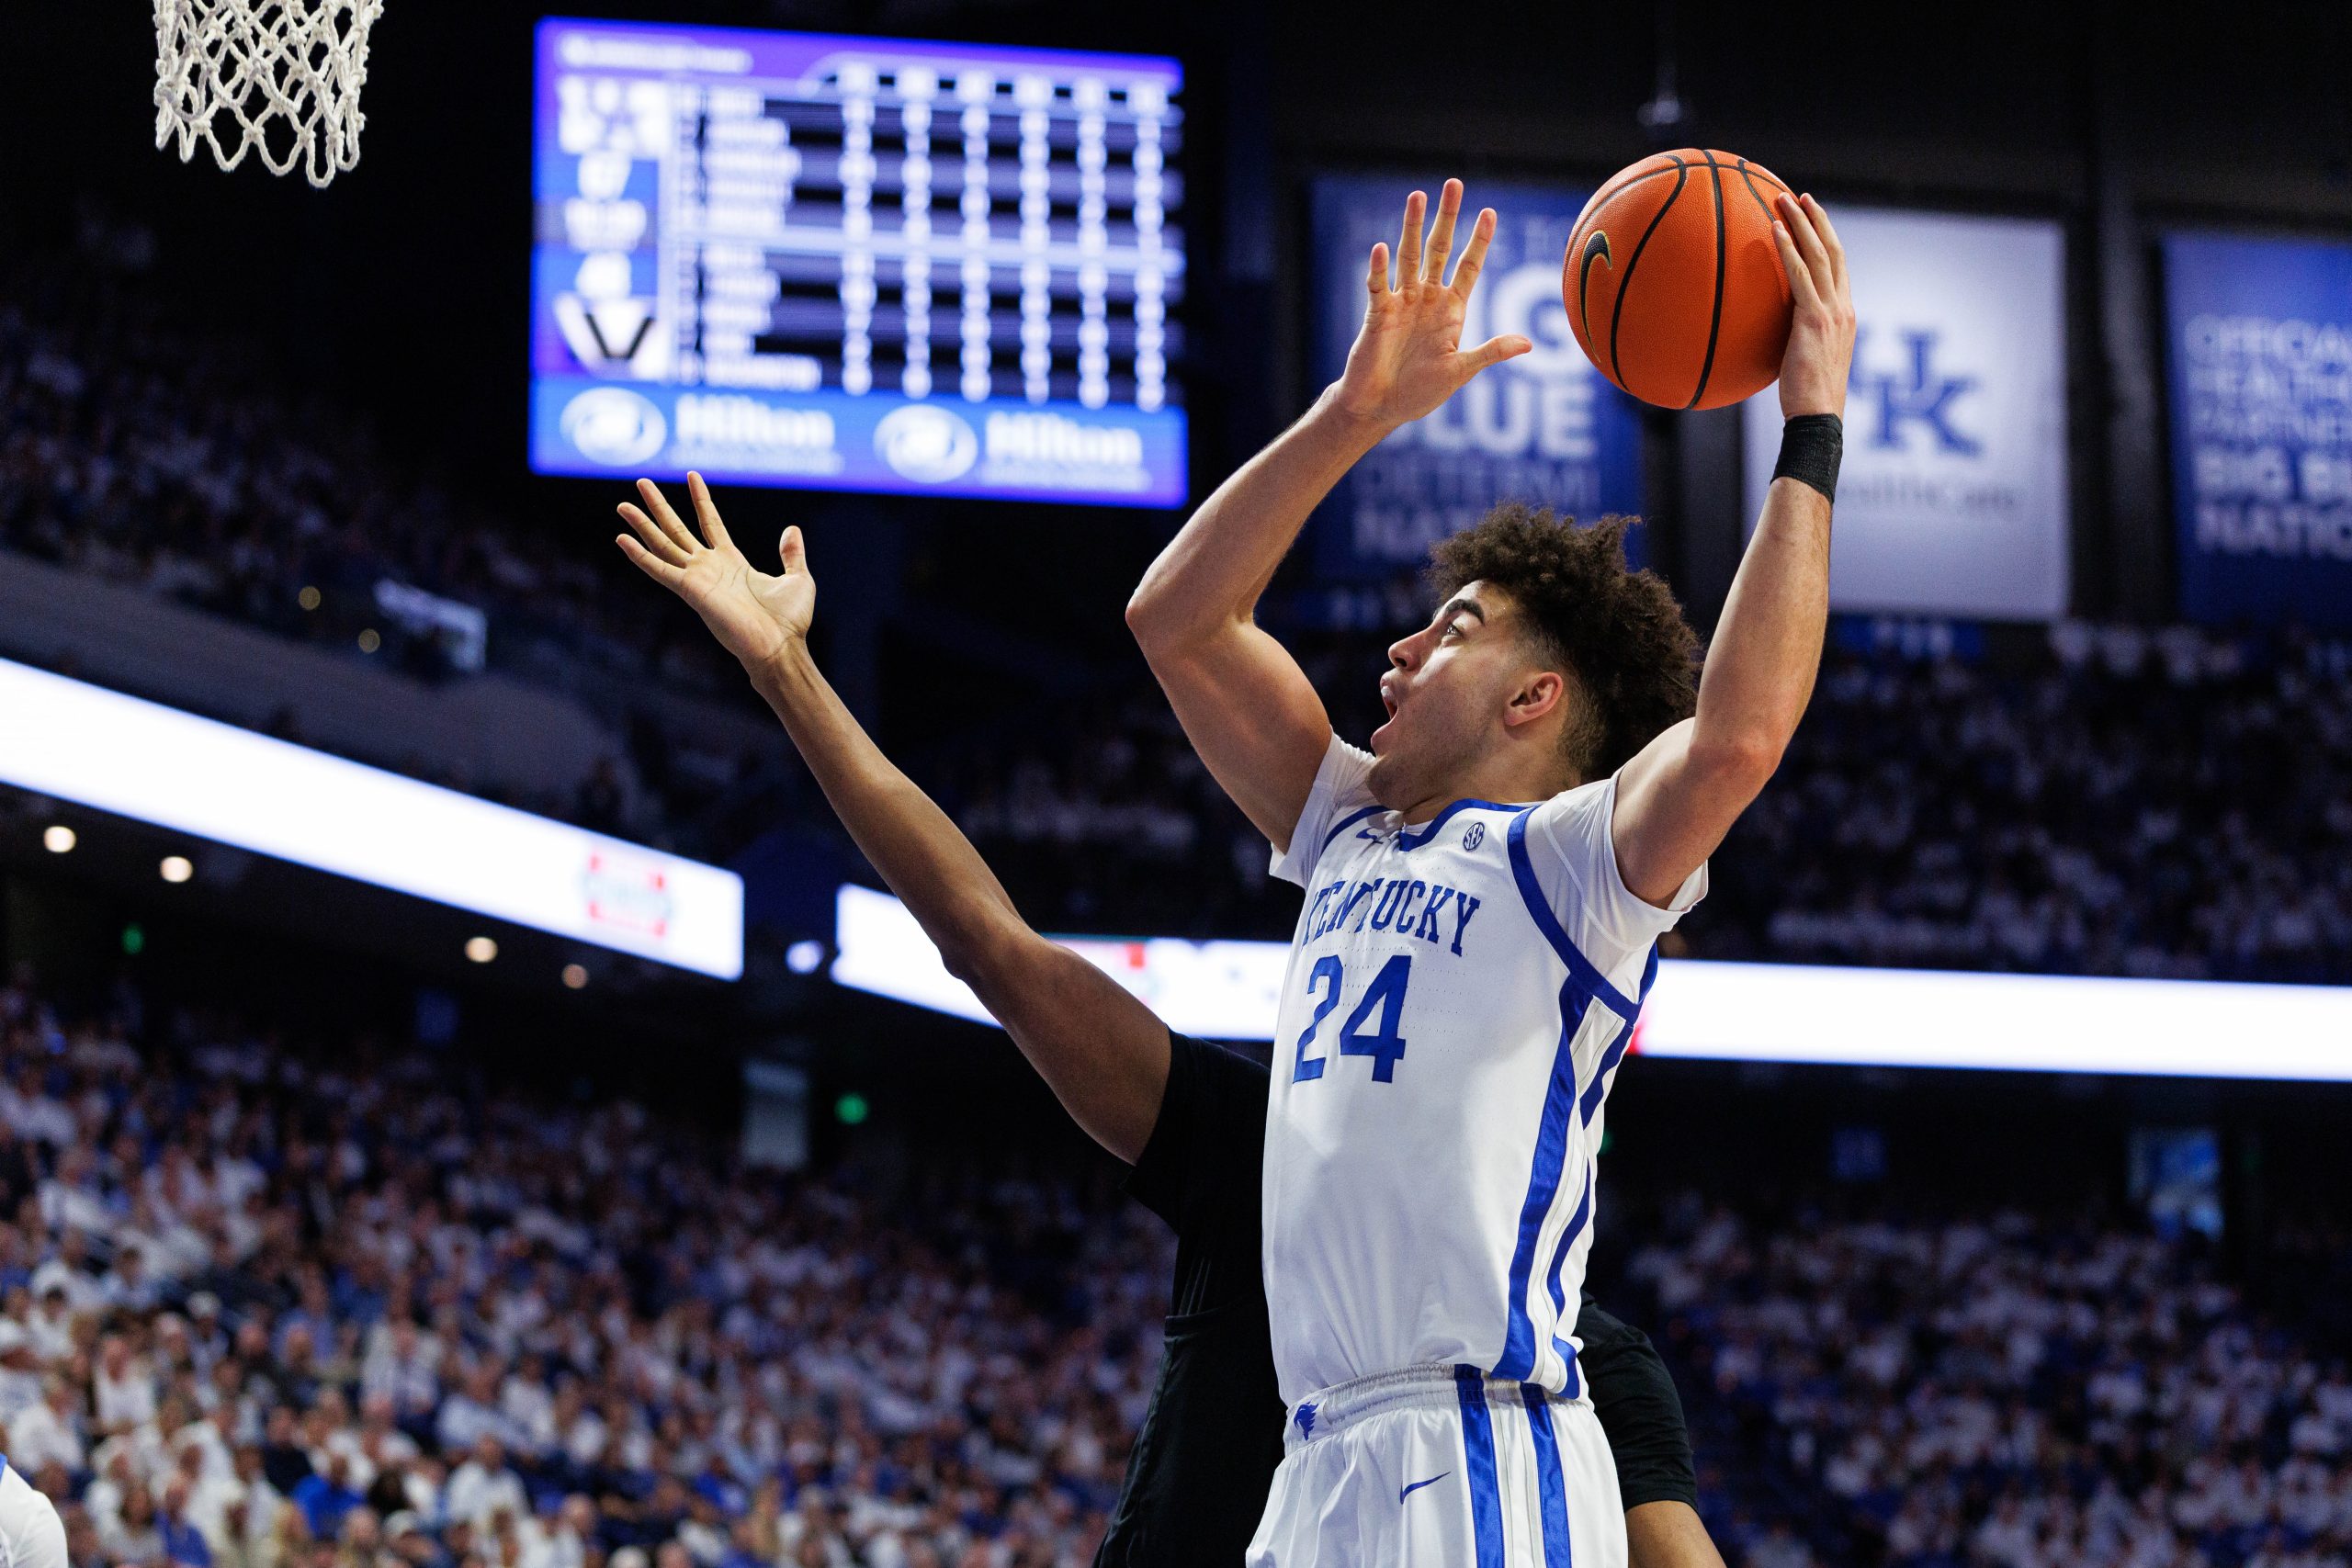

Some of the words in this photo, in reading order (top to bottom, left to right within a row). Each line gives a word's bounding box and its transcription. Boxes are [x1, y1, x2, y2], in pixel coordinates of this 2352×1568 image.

[1379, 375, 1598, 457] LUE
[1464, 822, 1485, 852] SEC
[1302, 877, 1479, 957] KENTUCKY
[1292, 954, 1413, 1084] 24
